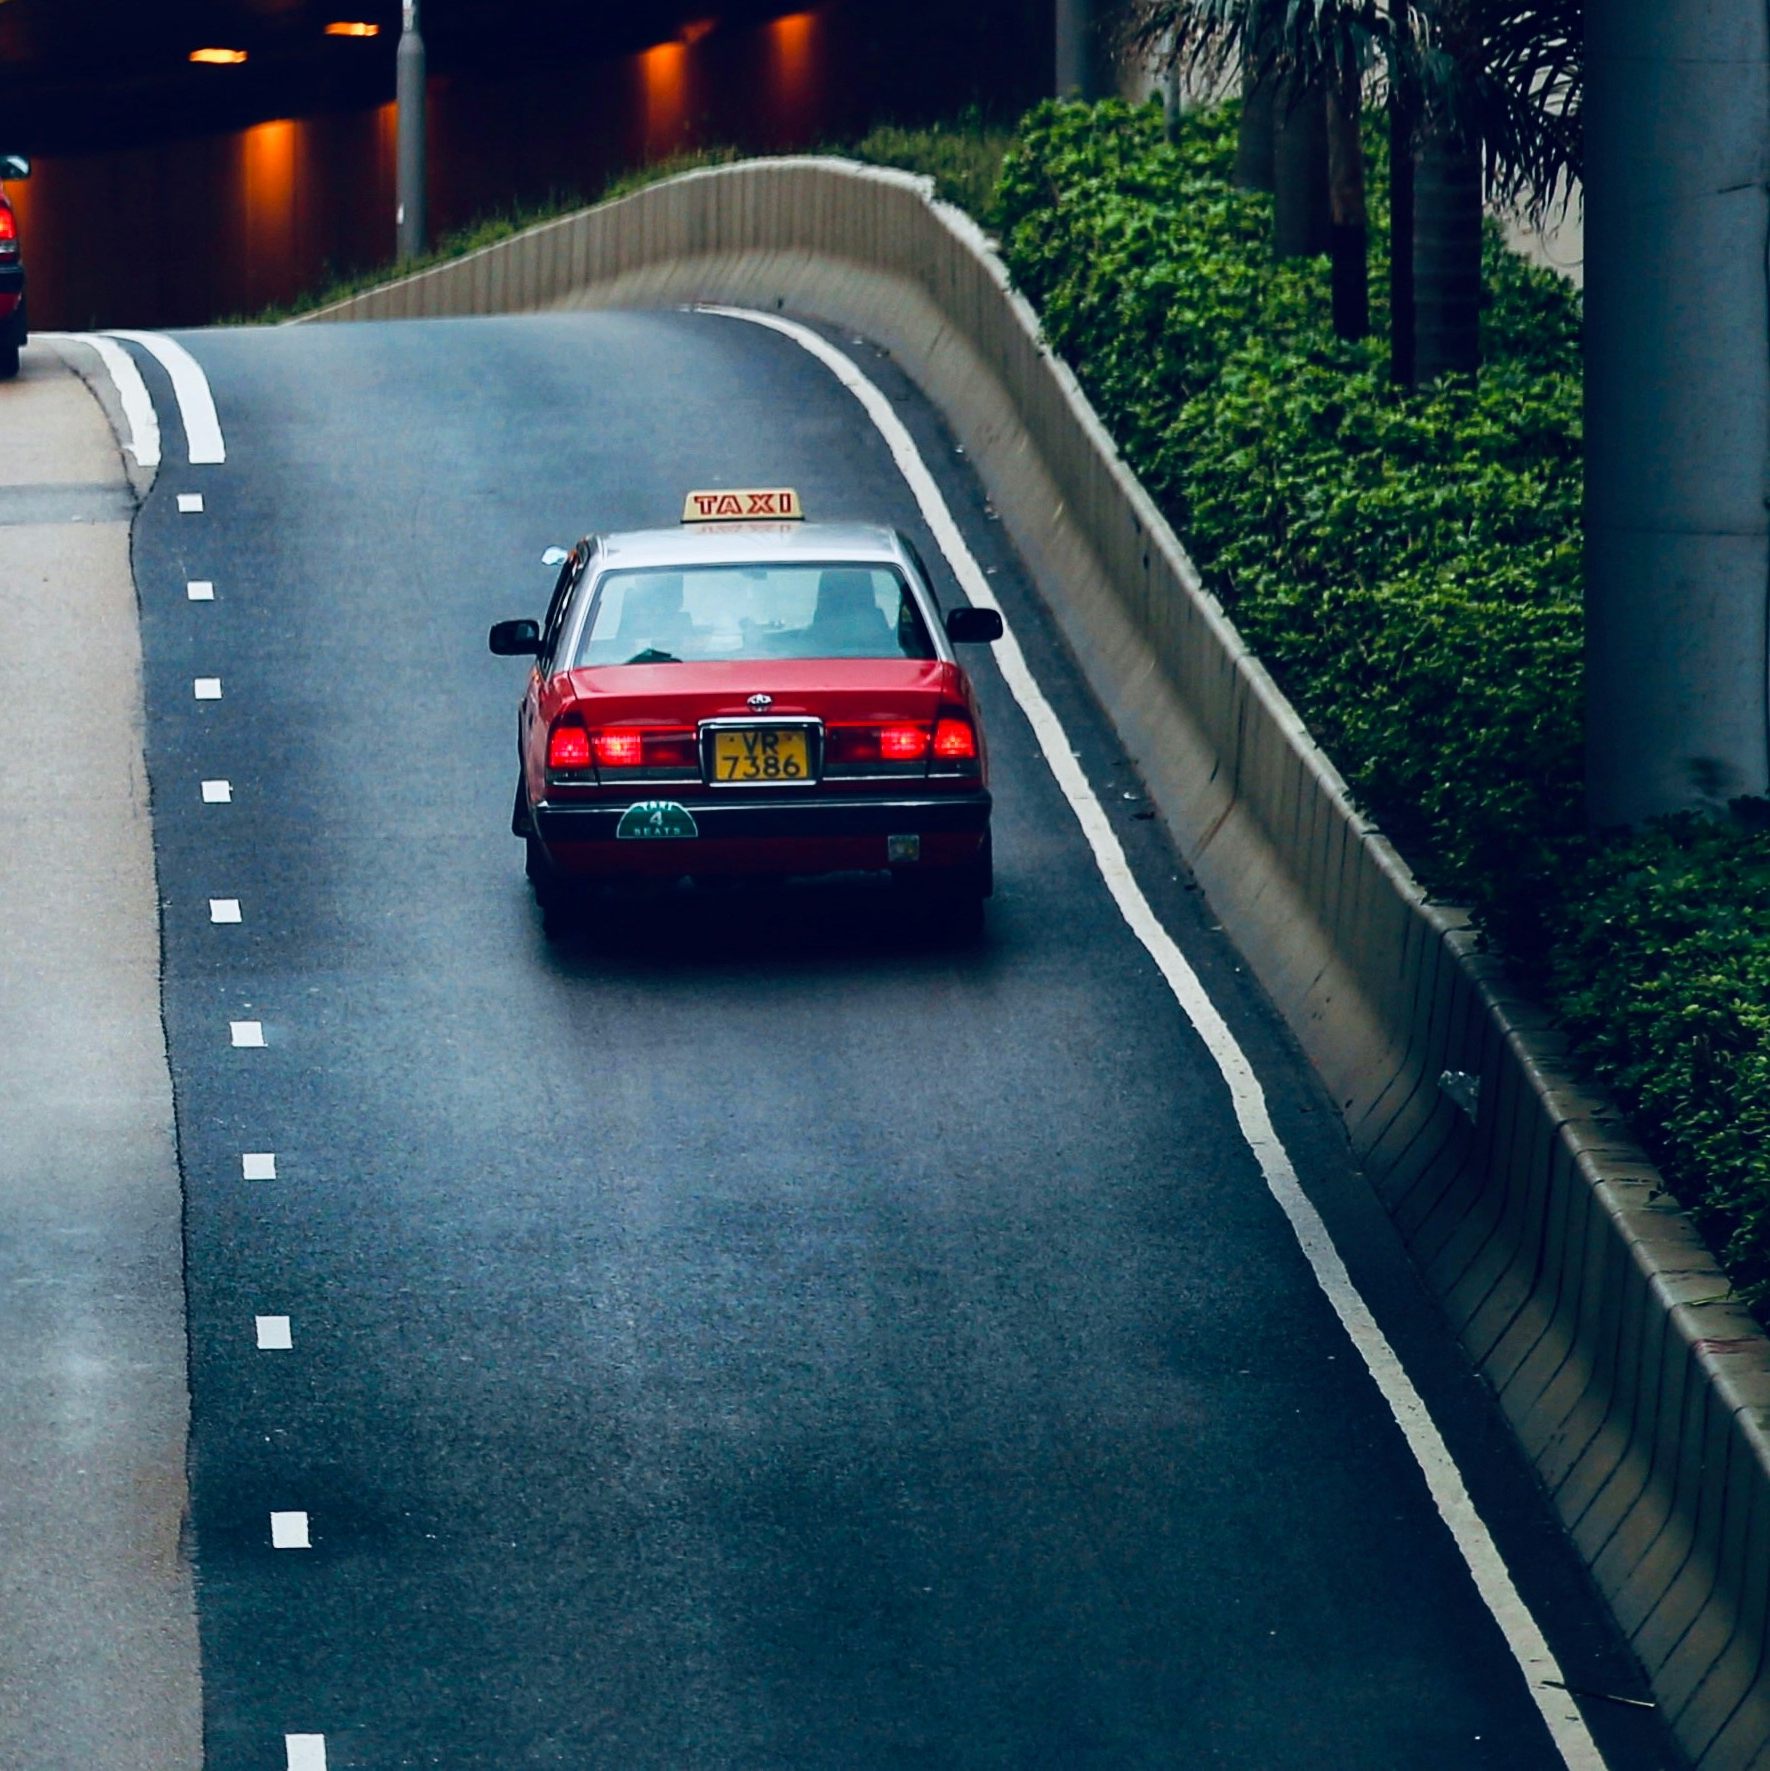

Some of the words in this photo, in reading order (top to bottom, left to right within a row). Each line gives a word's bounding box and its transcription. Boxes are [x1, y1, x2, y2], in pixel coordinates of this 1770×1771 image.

[694, 493, 791, 515] TAXI
[742, 731, 779, 755] VR
[722, 754, 800, 779] 7386
[649, 810, 663, 826] 4
